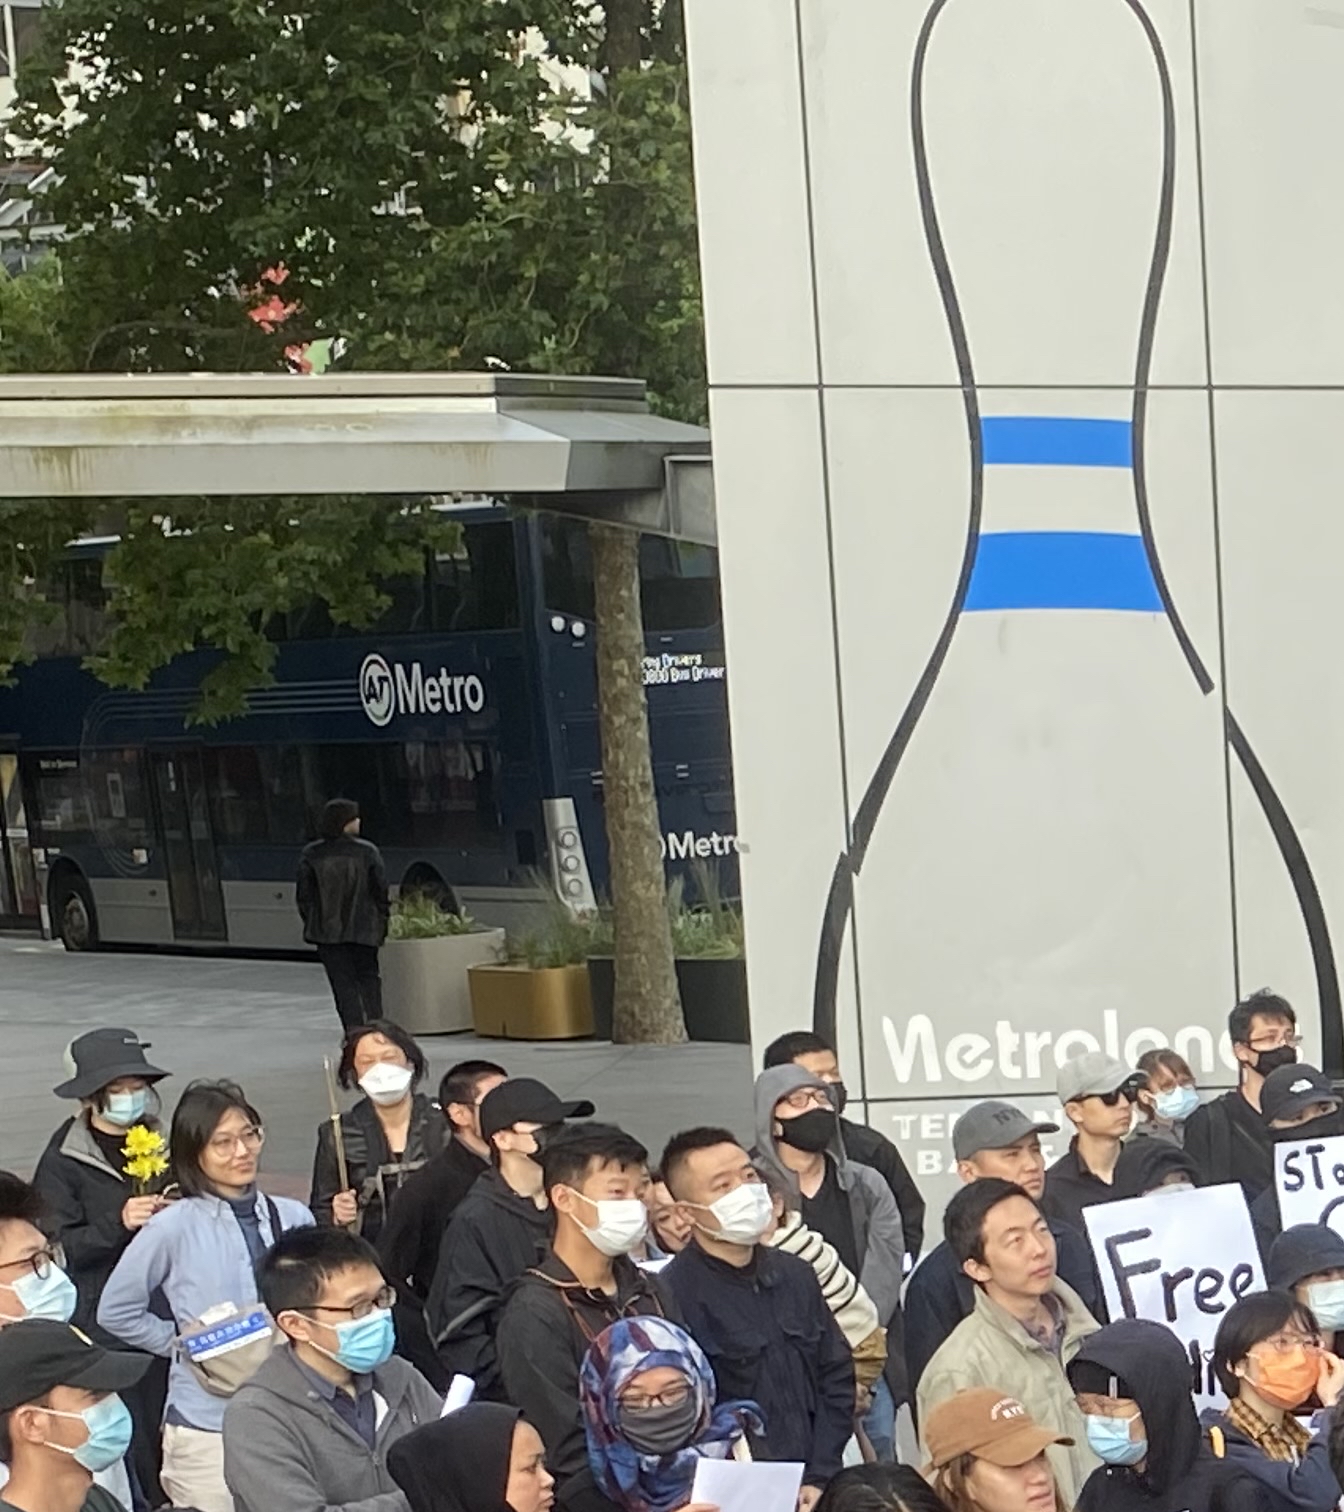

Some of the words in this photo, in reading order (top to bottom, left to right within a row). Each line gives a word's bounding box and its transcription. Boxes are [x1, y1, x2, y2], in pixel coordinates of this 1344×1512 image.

[394, 662, 484, 714] Metro
[668, 830, 739, 860] Metr
[882, 1009, 1304, 1084] Metrolan
[1104, 1227, 1255, 1322] Free
